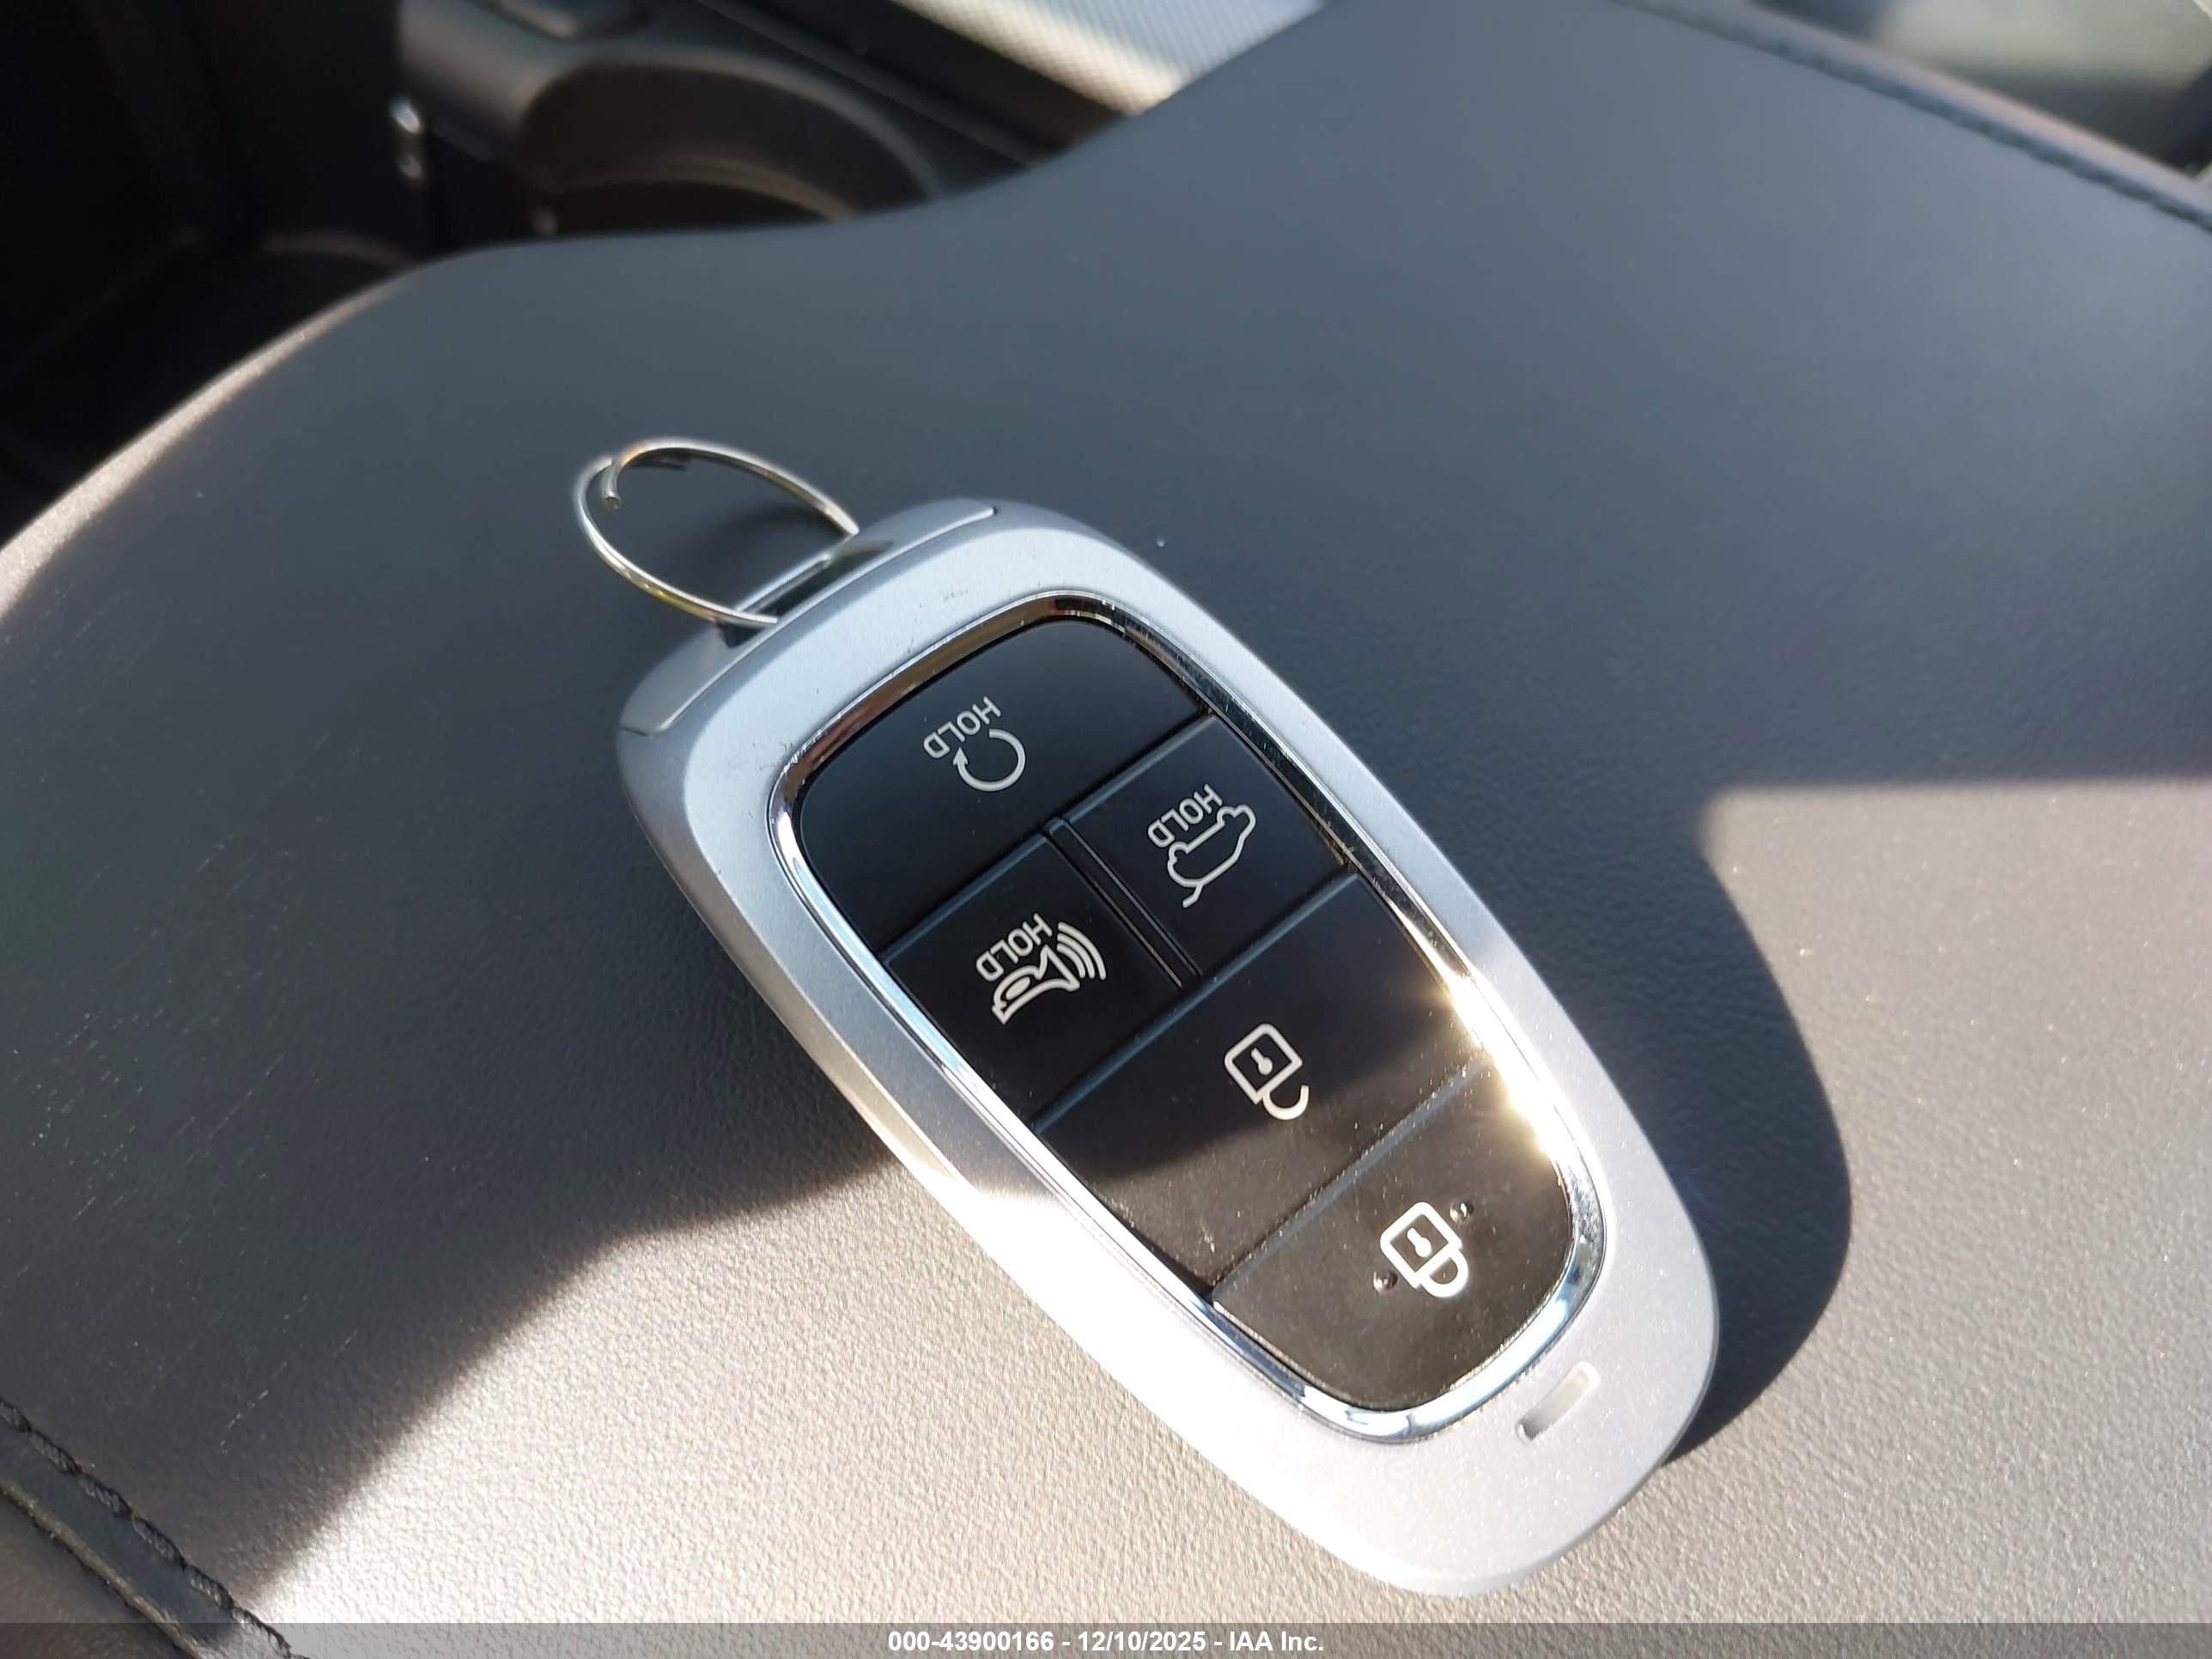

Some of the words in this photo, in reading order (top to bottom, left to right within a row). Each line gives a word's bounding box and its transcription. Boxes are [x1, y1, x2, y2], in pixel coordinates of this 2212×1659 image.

[923, 696, 1002, 759] HOLD
[1147, 783, 1224, 848] HOLD
[975, 913, 1054, 982] HOLD
